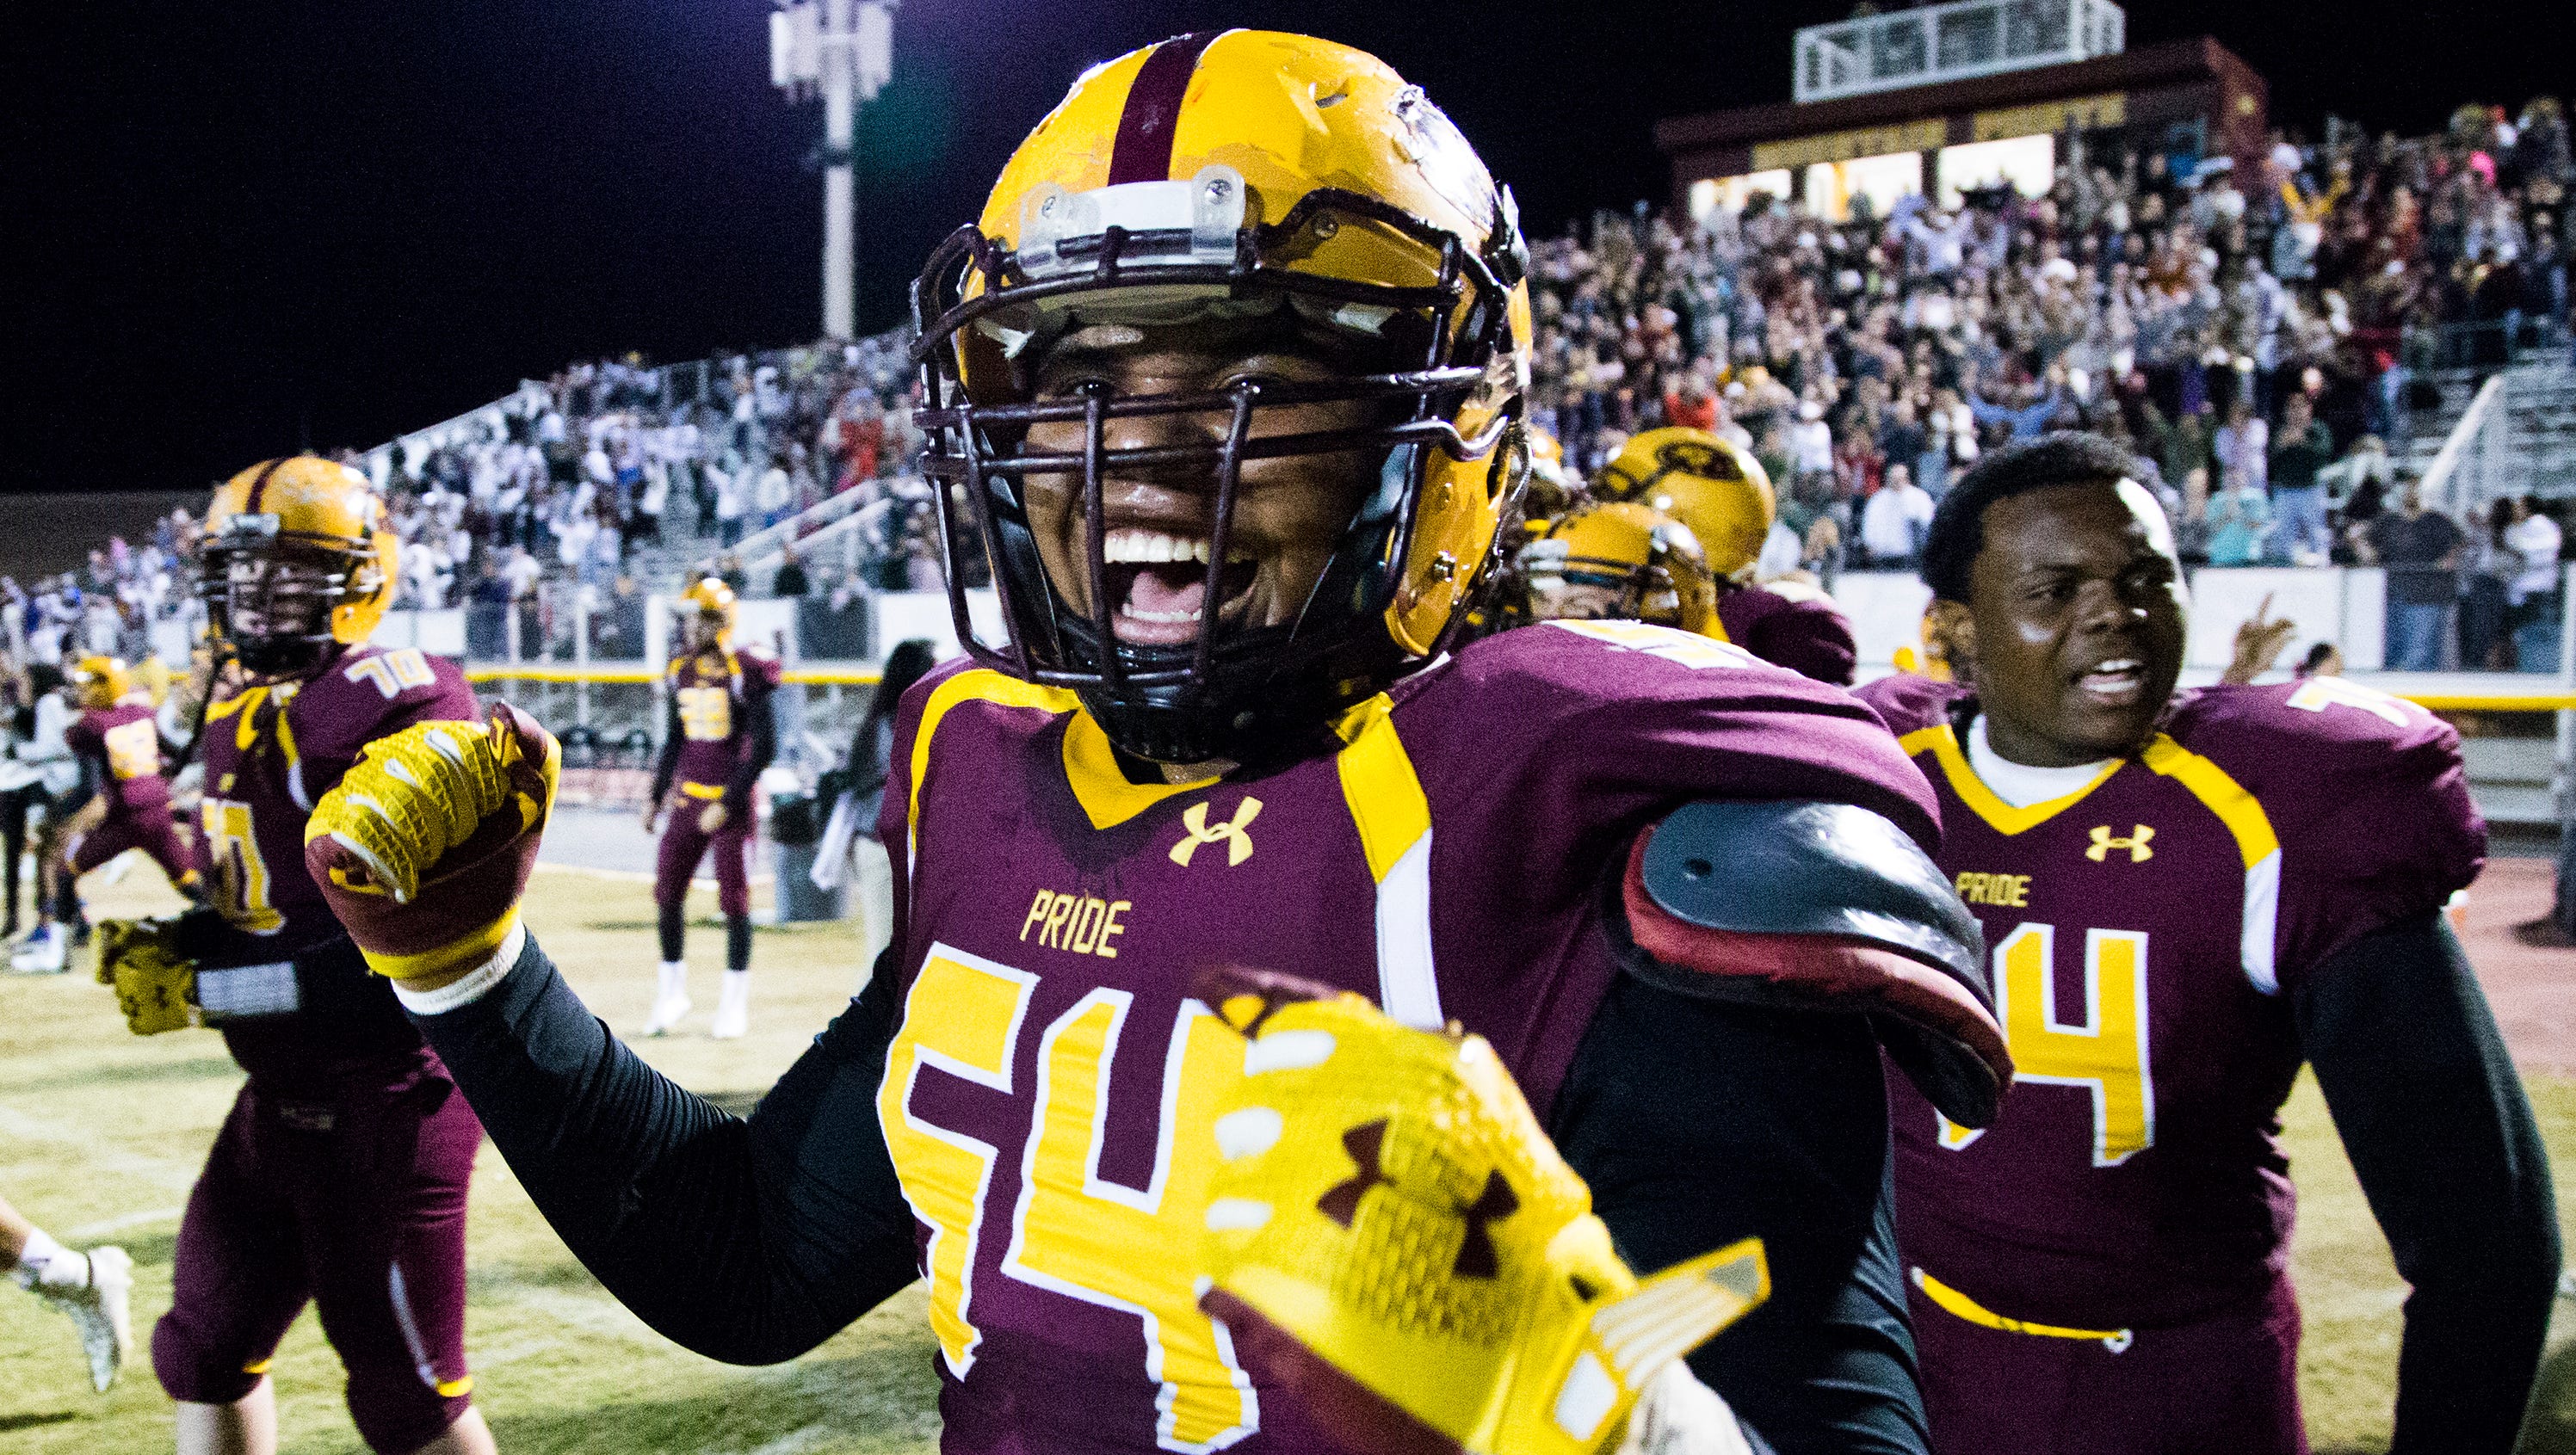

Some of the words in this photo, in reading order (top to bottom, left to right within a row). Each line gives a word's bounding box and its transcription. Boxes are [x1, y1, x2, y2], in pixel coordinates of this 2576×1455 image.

[344, 647, 436, 700] 70
[1019, 888, 1132, 959] PRIDE
[1955, 872, 2032, 908] PRIDE
[1937, 922, 2155, 1168] 4
[876, 940, 1259, 1454] 54
